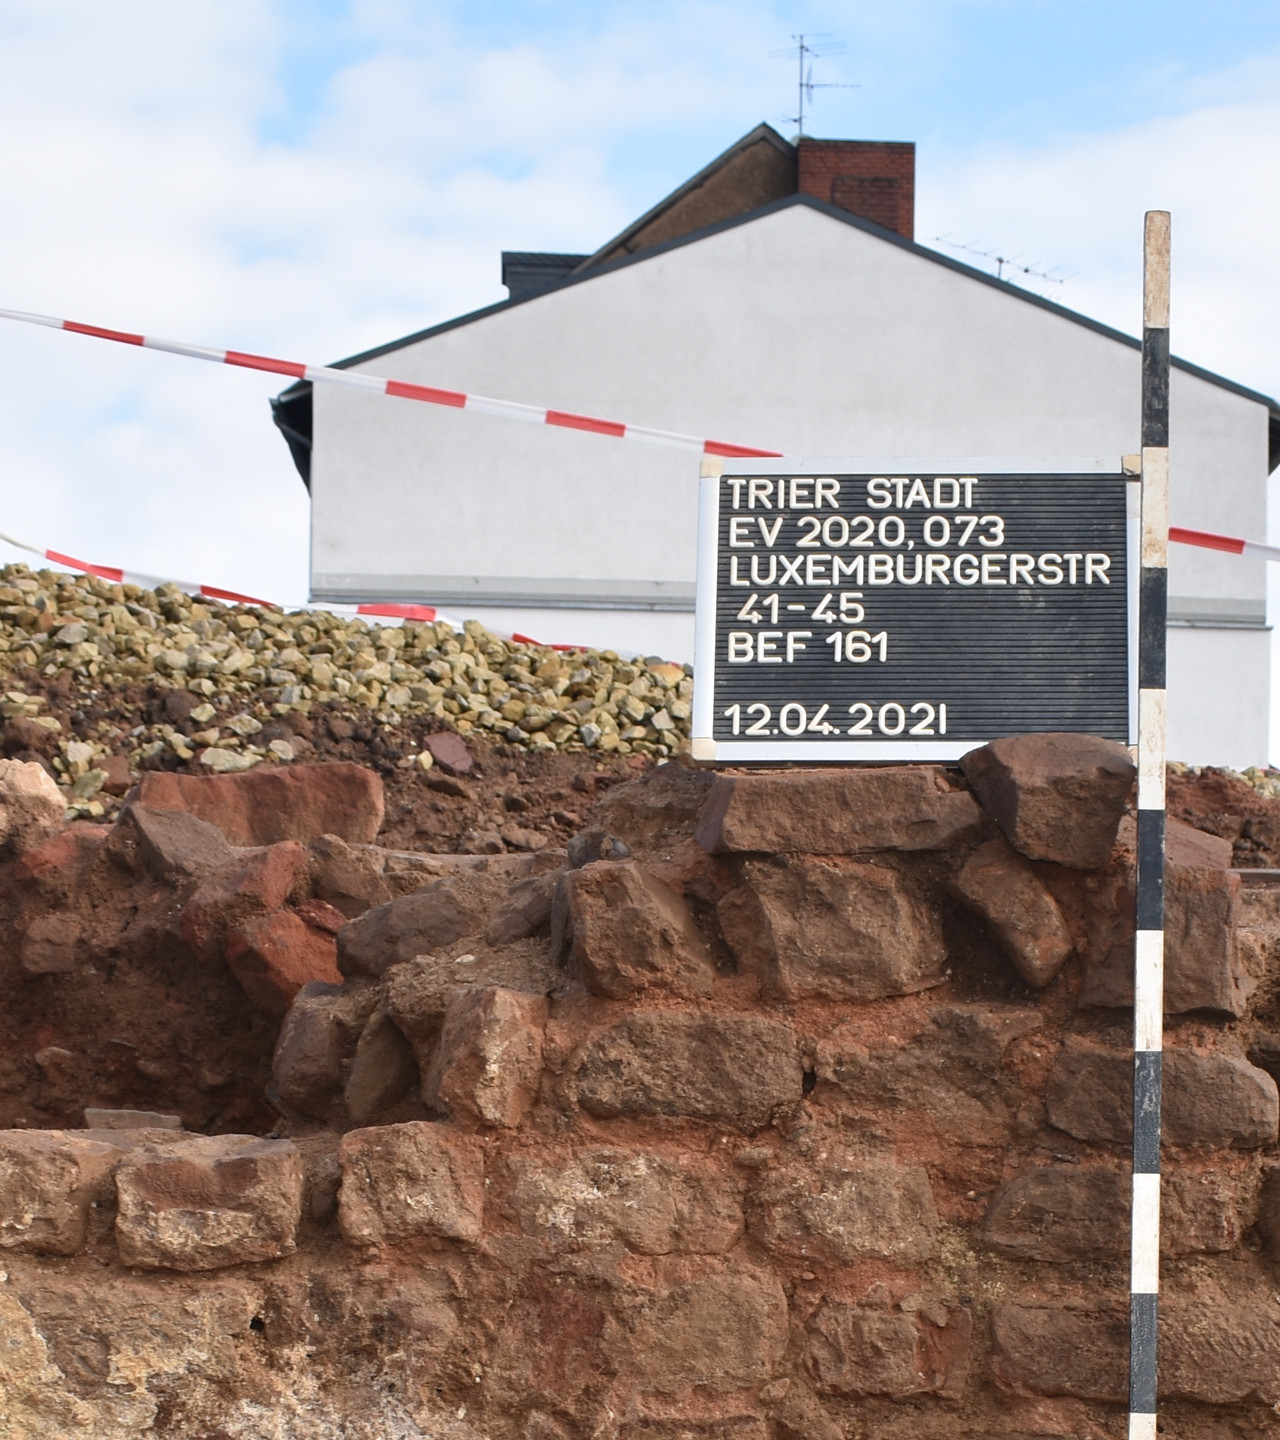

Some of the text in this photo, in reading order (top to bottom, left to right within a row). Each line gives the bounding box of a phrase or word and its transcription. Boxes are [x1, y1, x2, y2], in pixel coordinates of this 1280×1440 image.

[726, 477, 979, 510] TRIER STADT
[729, 516, 784, 548] EV
[729, 553, 1111, 586] LUXEMBURGERSTR
[736, 592, 866, 625] 41-45
[728, 630, 888, 663] BEF 161
[724, 702, 947, 736] 12.04.2021
